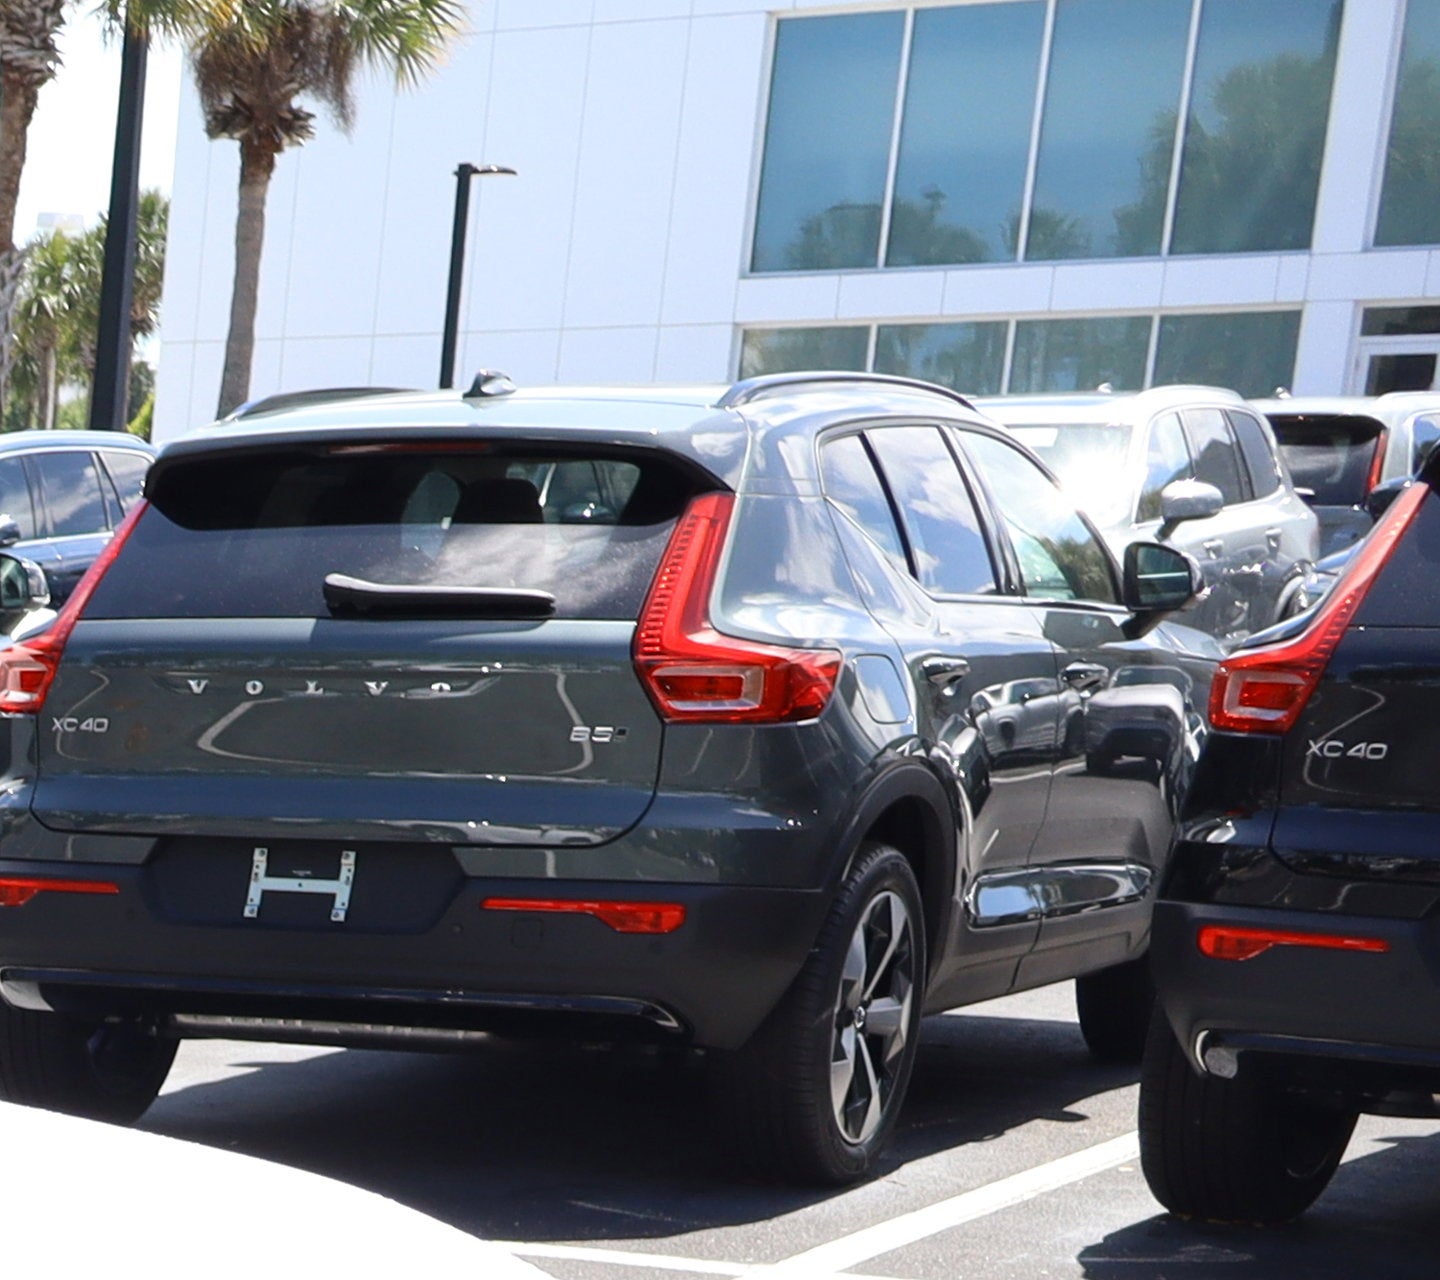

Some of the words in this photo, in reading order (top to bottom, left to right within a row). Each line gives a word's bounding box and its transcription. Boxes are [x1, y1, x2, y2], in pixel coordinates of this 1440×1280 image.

[187, 679, 452, 696] VOLVO
[51, 717, 109, 733] XC40
[570, 726, 614, 743] B5
[1305, 739, 1388, 760] XC40
